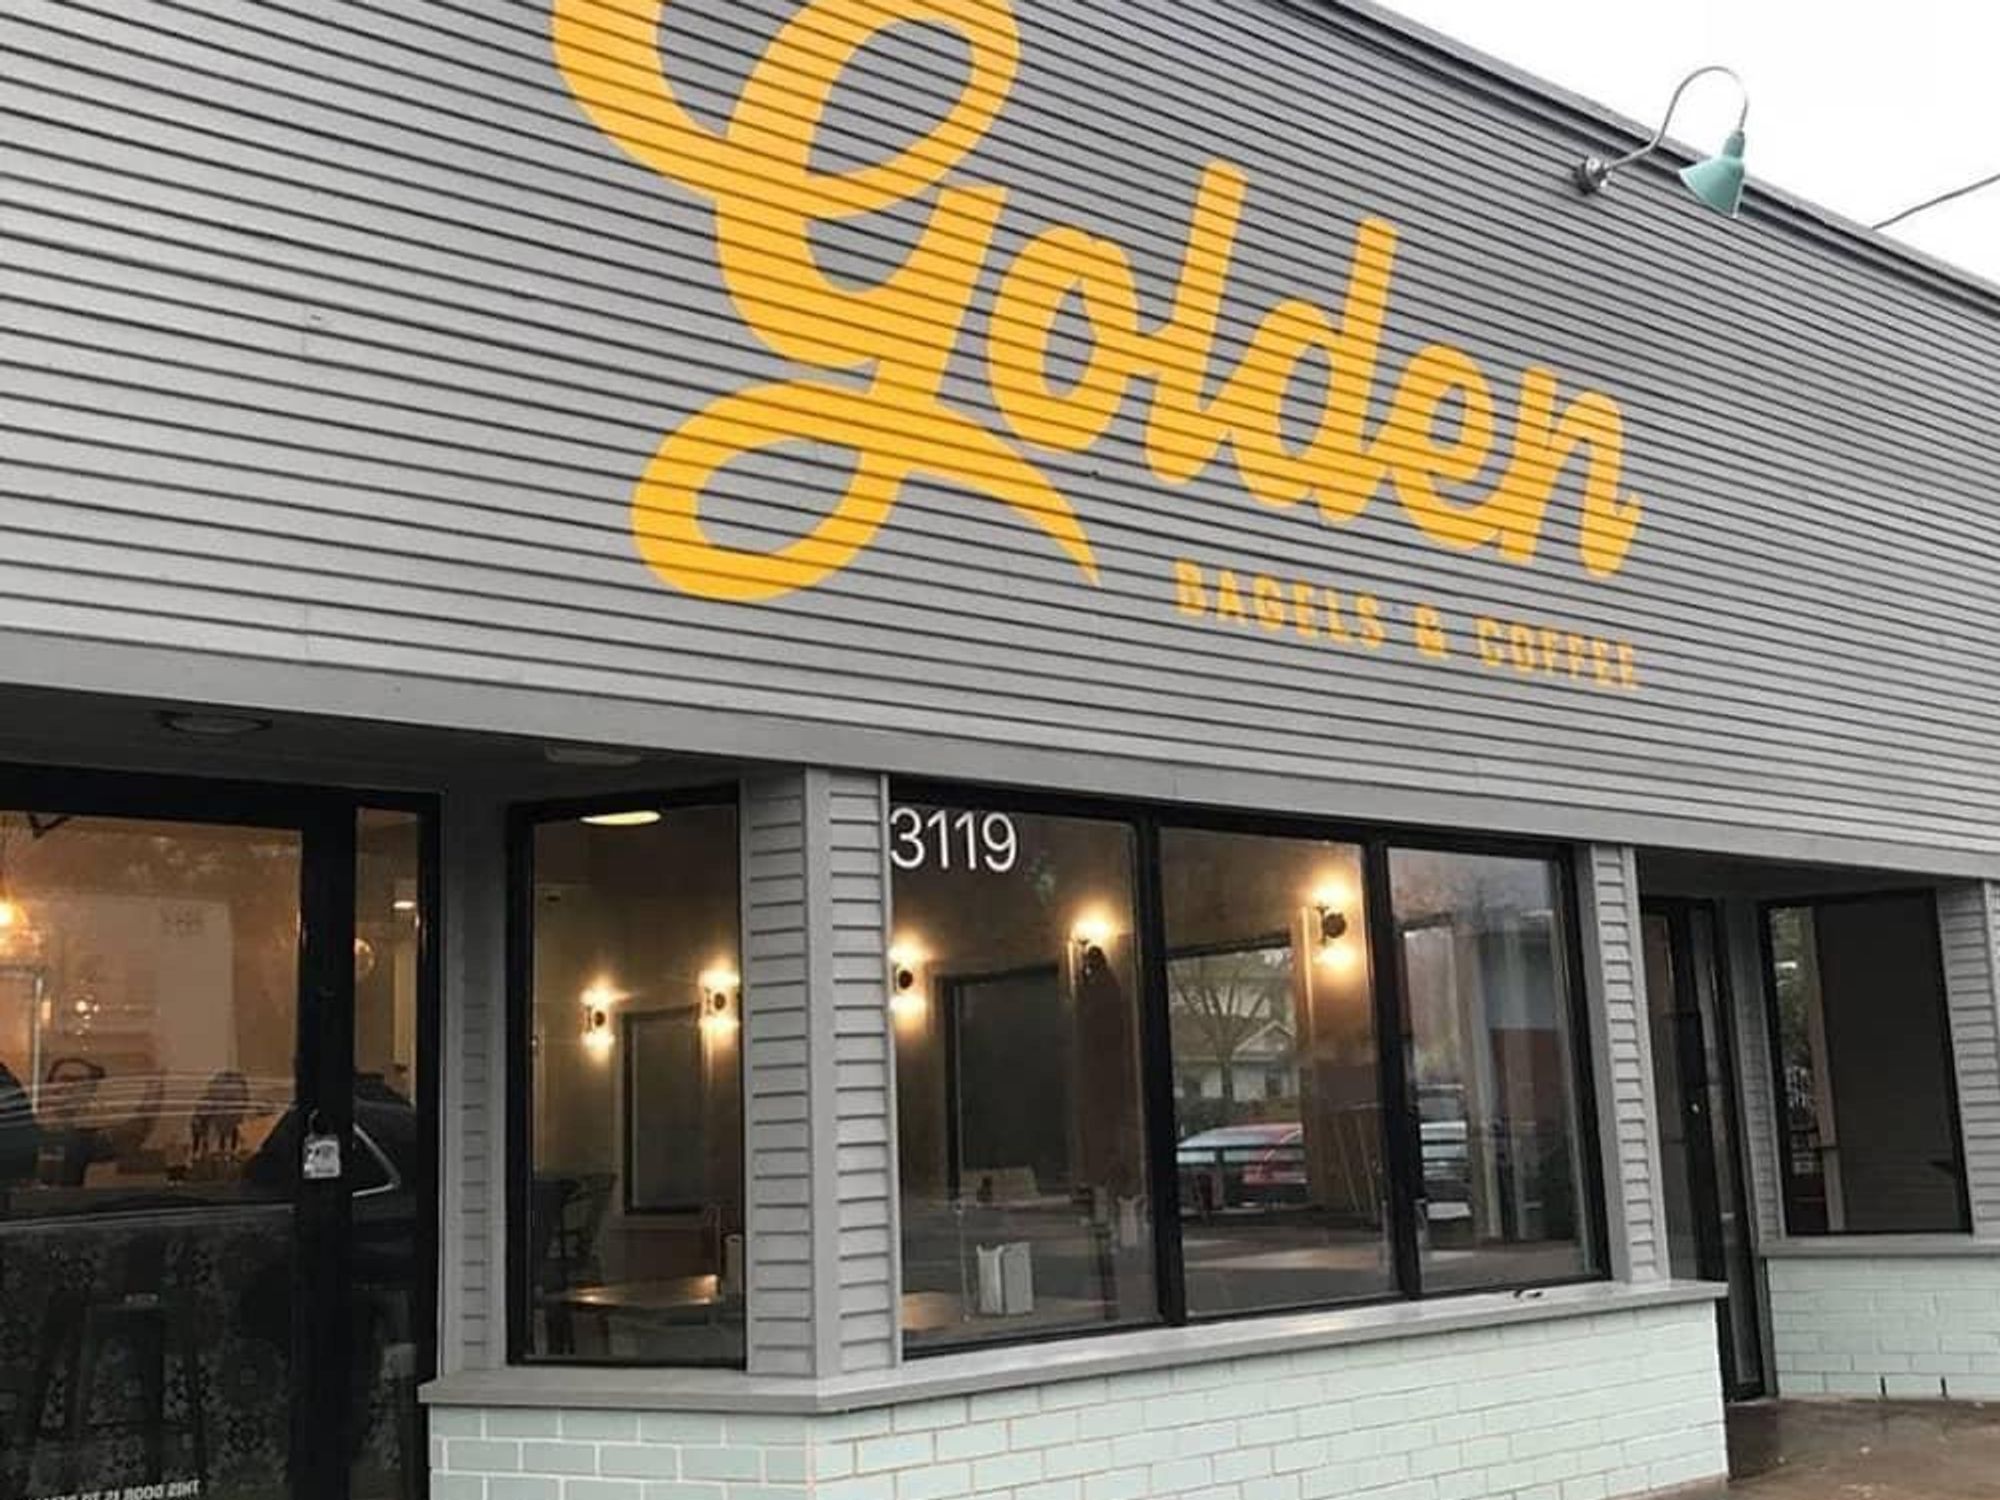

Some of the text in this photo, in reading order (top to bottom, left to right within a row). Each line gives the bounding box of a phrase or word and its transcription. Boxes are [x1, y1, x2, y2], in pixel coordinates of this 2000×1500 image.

[551, 0, 1642, 600] Golden
[1172, 558, 1640, 689] BAGELS & COFFEE
[890, 807, 1017, 872] 3119
